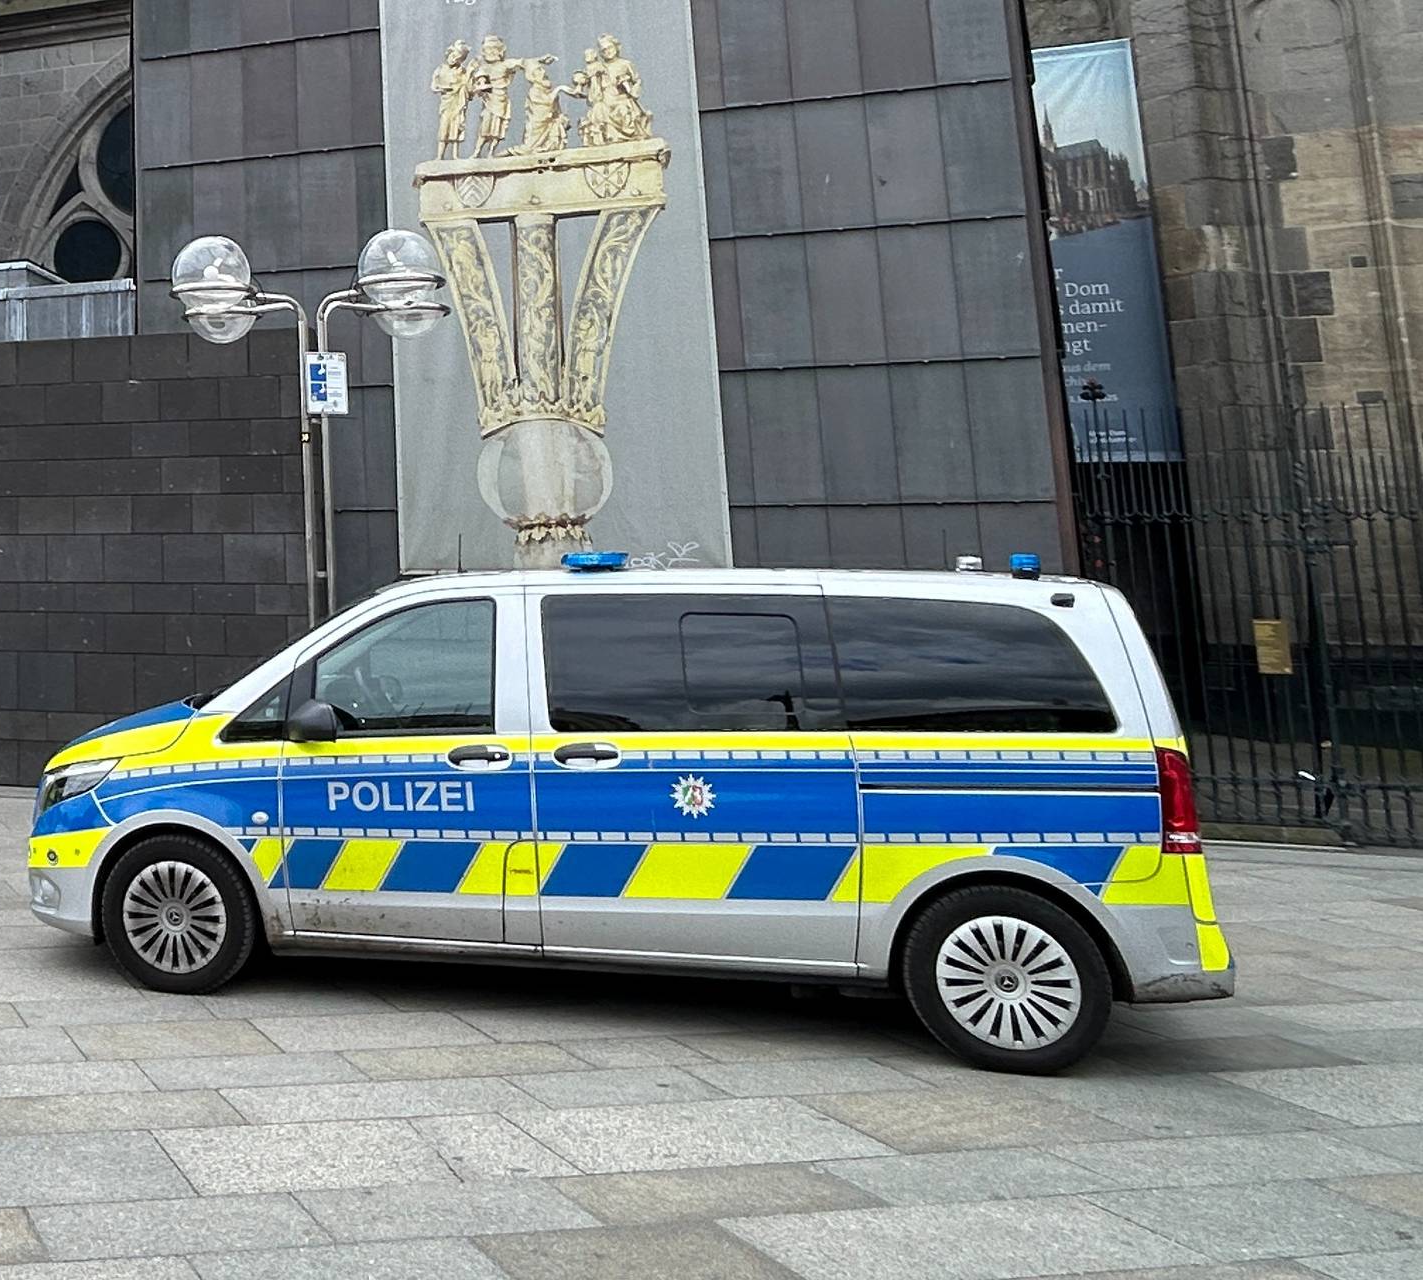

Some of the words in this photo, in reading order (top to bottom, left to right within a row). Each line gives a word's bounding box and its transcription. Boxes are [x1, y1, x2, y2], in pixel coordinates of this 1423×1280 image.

[1064, 282, 1110, 297] Dom
[1068, 298, 1125, 315] damit
[327, 780, 475, 812] POLIZEI
